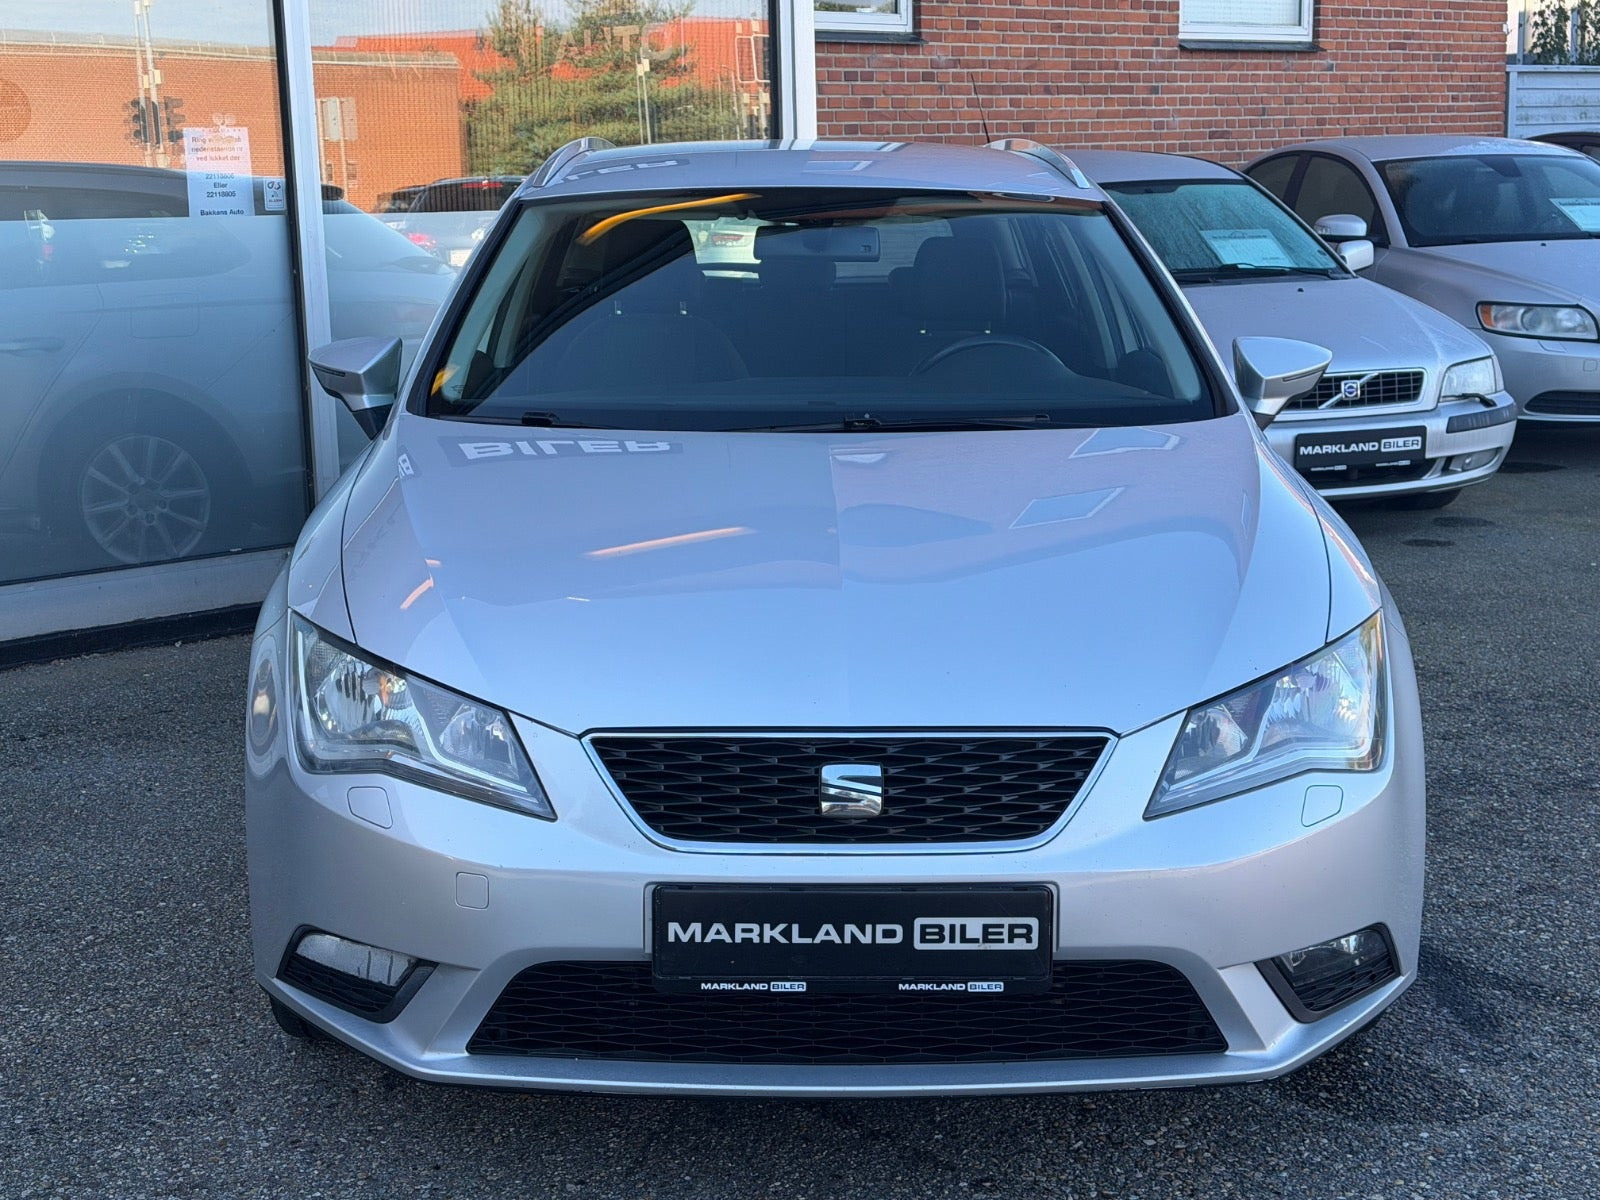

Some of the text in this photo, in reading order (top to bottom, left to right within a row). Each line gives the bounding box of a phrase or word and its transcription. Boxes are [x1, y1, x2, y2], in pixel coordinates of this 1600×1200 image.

[229, 208, 245, 216] Auto
[1300, 437, 1421, 456] MARKLAND BILER
[668, 921, 1035, 946] MARKLAND BILER
[701, 982, 805, 991] MARKLAND BILER
[899, 982, 1002, 992] MARKLAND BILER
